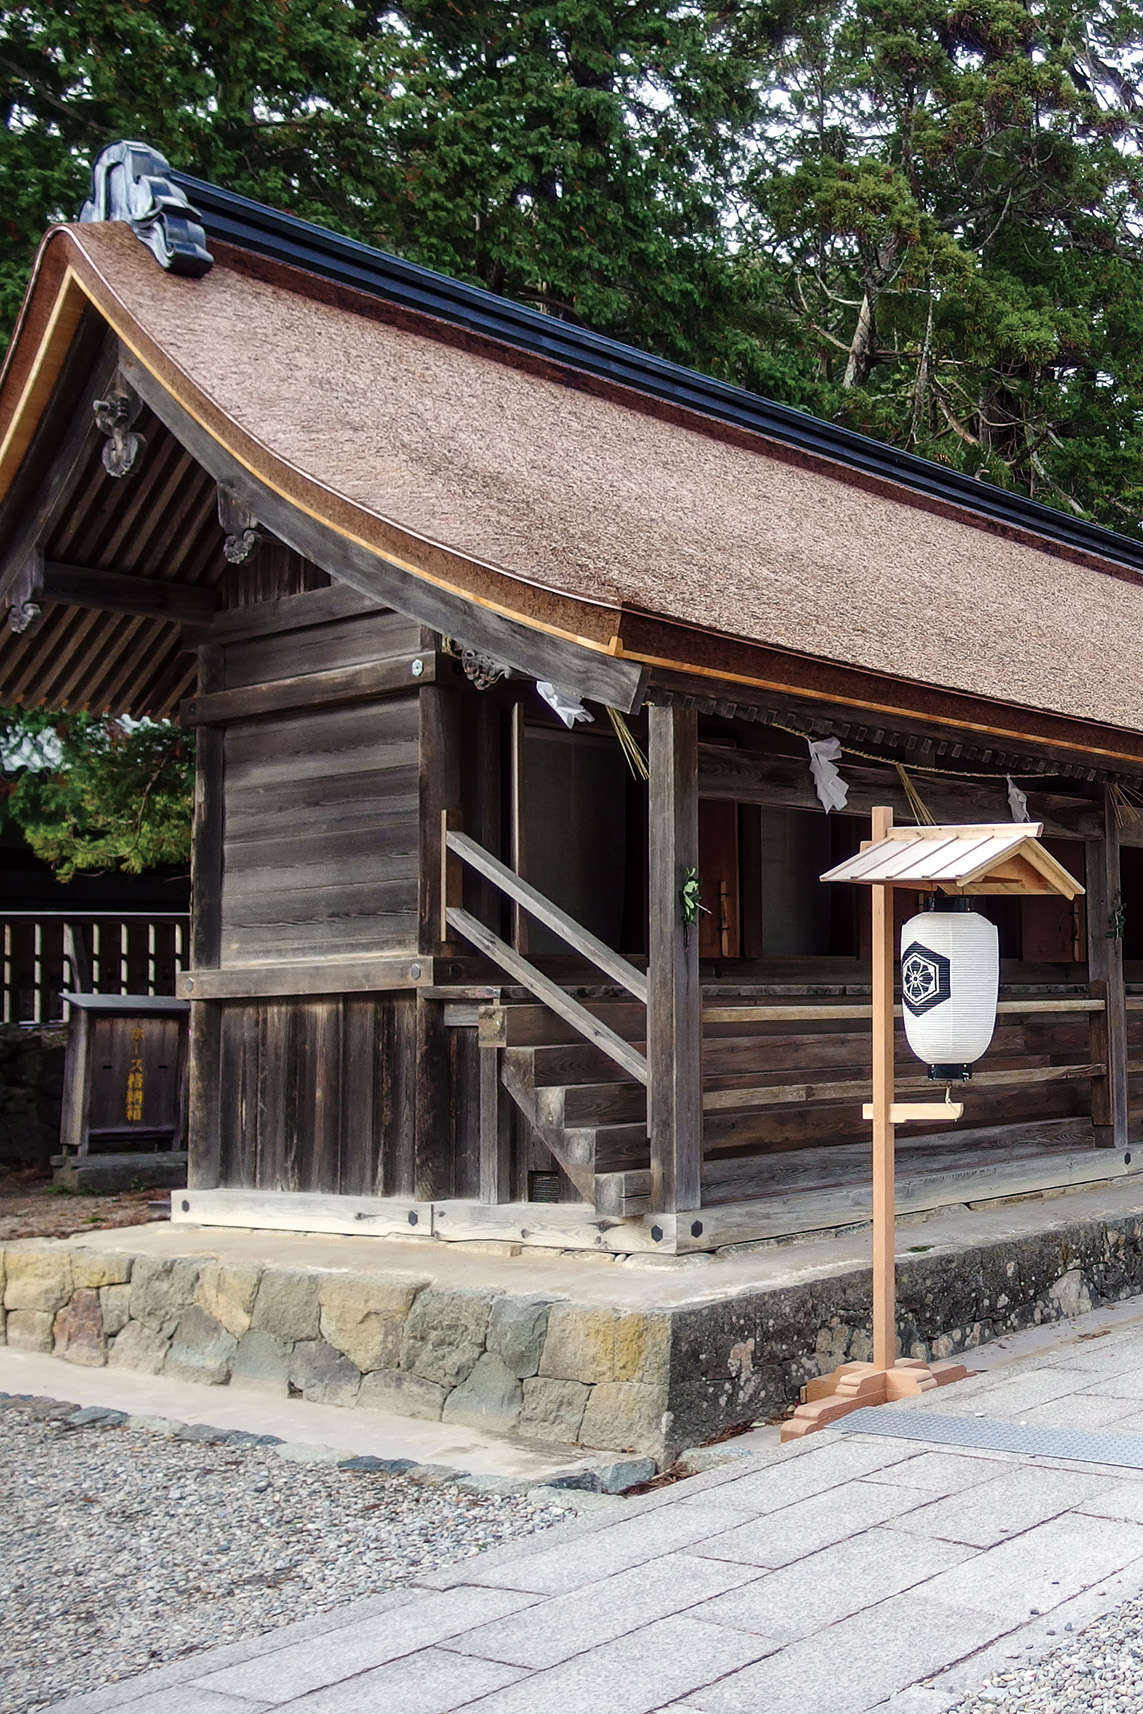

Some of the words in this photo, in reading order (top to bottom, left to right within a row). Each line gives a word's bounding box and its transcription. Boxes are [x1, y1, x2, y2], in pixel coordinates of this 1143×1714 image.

[125, 1027, 145, 1121] ホース格納箱
